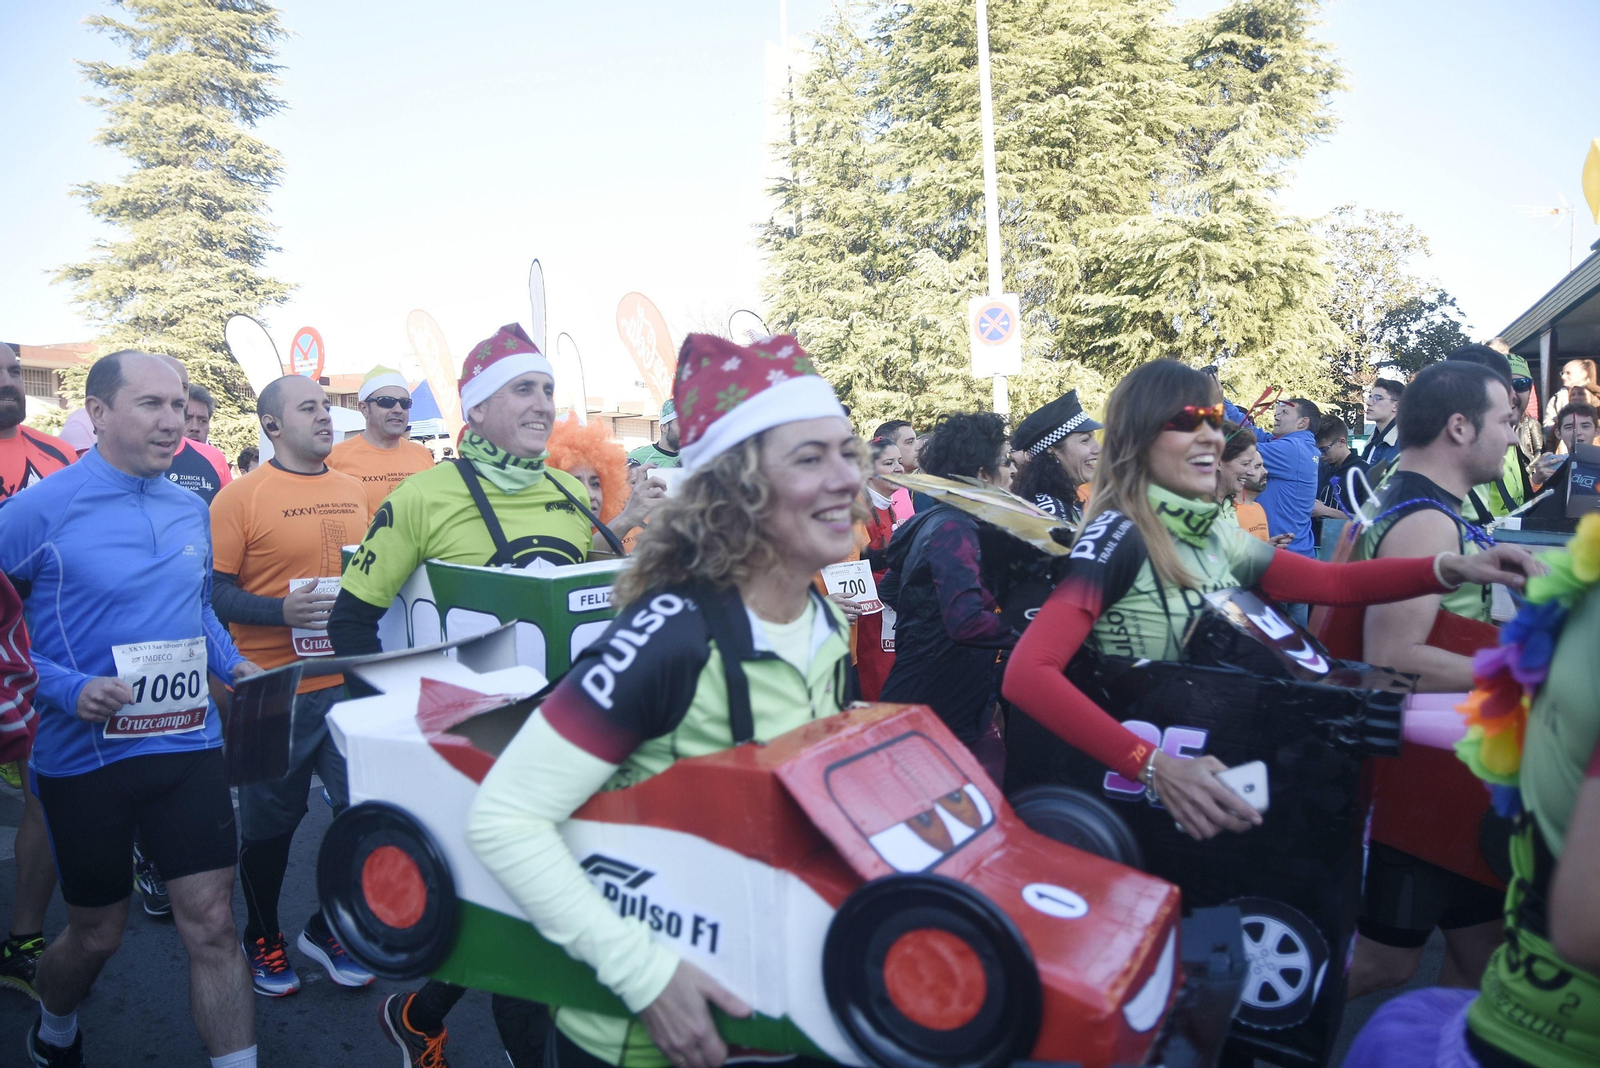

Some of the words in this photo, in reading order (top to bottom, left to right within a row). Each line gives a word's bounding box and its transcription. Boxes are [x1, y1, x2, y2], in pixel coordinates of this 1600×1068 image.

[281, 507, 317, 518] XXXVI
[1097, 541, 1118, 564] TRAIL
[838, 578, 866, 596] 700
[142, 654, 173, 663] IMDECO
[132, 670, 200, 704] 1060
[116, 713, 192, 731] Cruzcampo
[691, 914, 720, 954] F1
